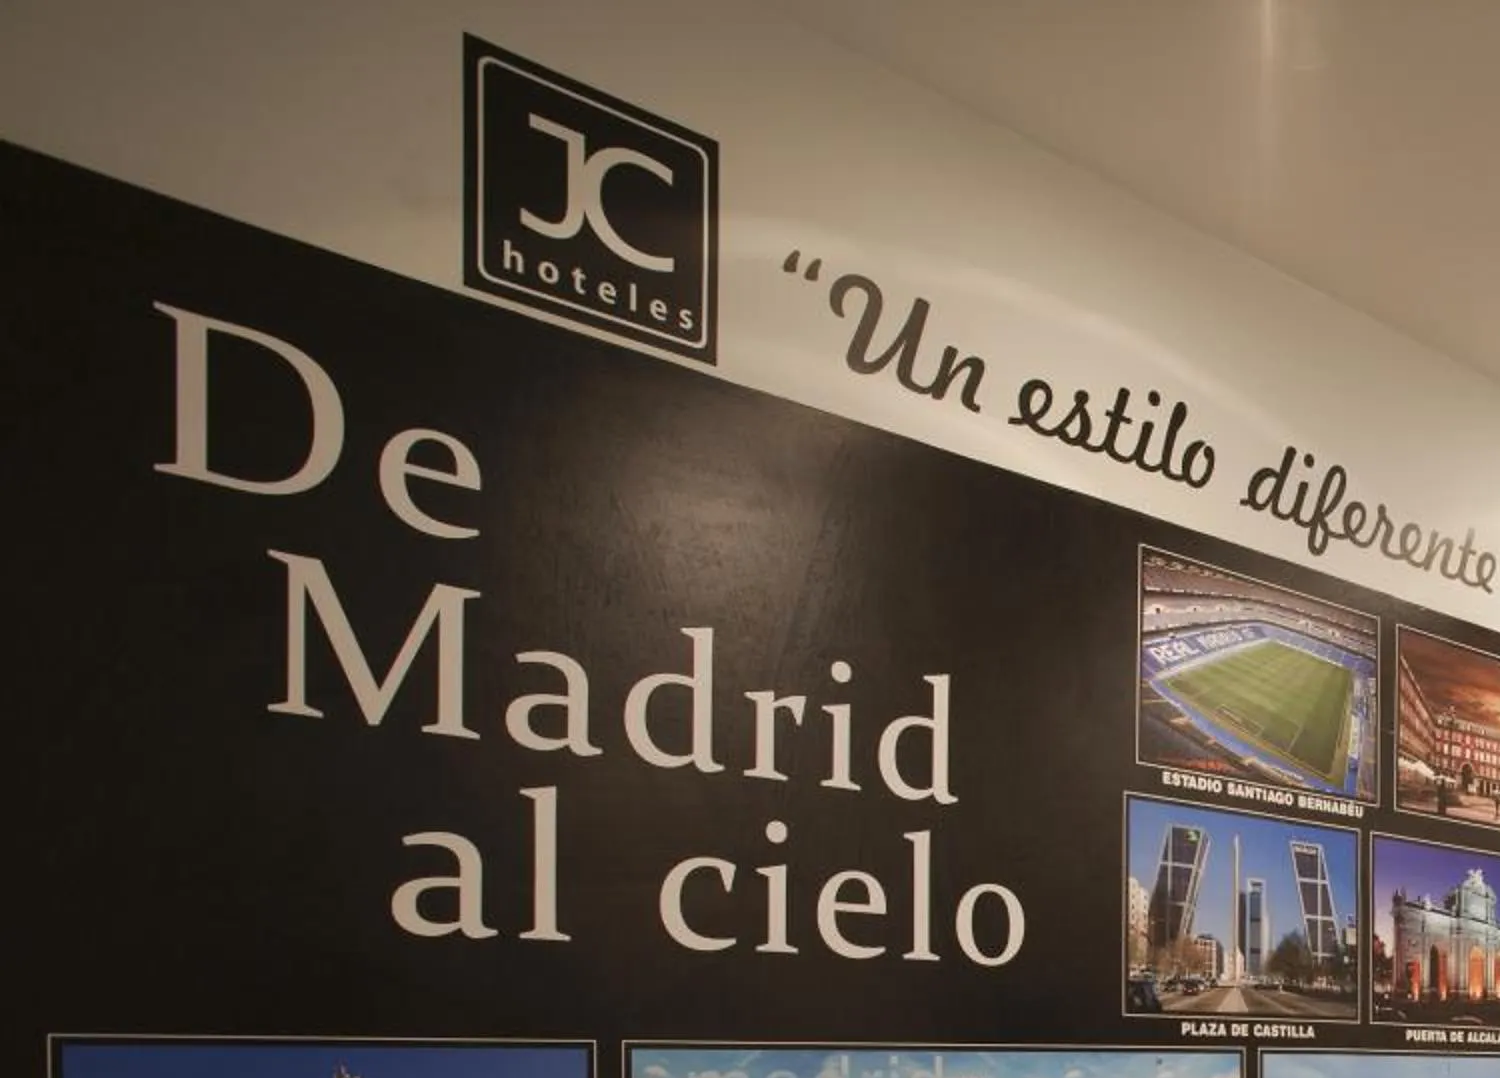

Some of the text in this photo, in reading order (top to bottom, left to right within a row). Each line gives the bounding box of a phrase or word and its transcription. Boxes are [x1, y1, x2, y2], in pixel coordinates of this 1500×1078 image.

[520, 113, 674, 272] JC
[502, 239, 694, 330] hoteles
[153, 301, 482, 539] De
[1008, 379, 1215, 488] estilo
[1239, 446, 1496, 594] diferente
[267, 548, 958, 804] Madrid
[1162, 771, 1223, 794] ESTADIO
[1227, 783, 1294, 806] SANTIAGO
[391, 785, 1026, 967] al cielo
[1181, 1021, 1316, 1038] PLAZA DE CASTILLA
[1405, 1028, 1447, 1042] PUERTA
[1450, 1031, 1464, 1043] DE
